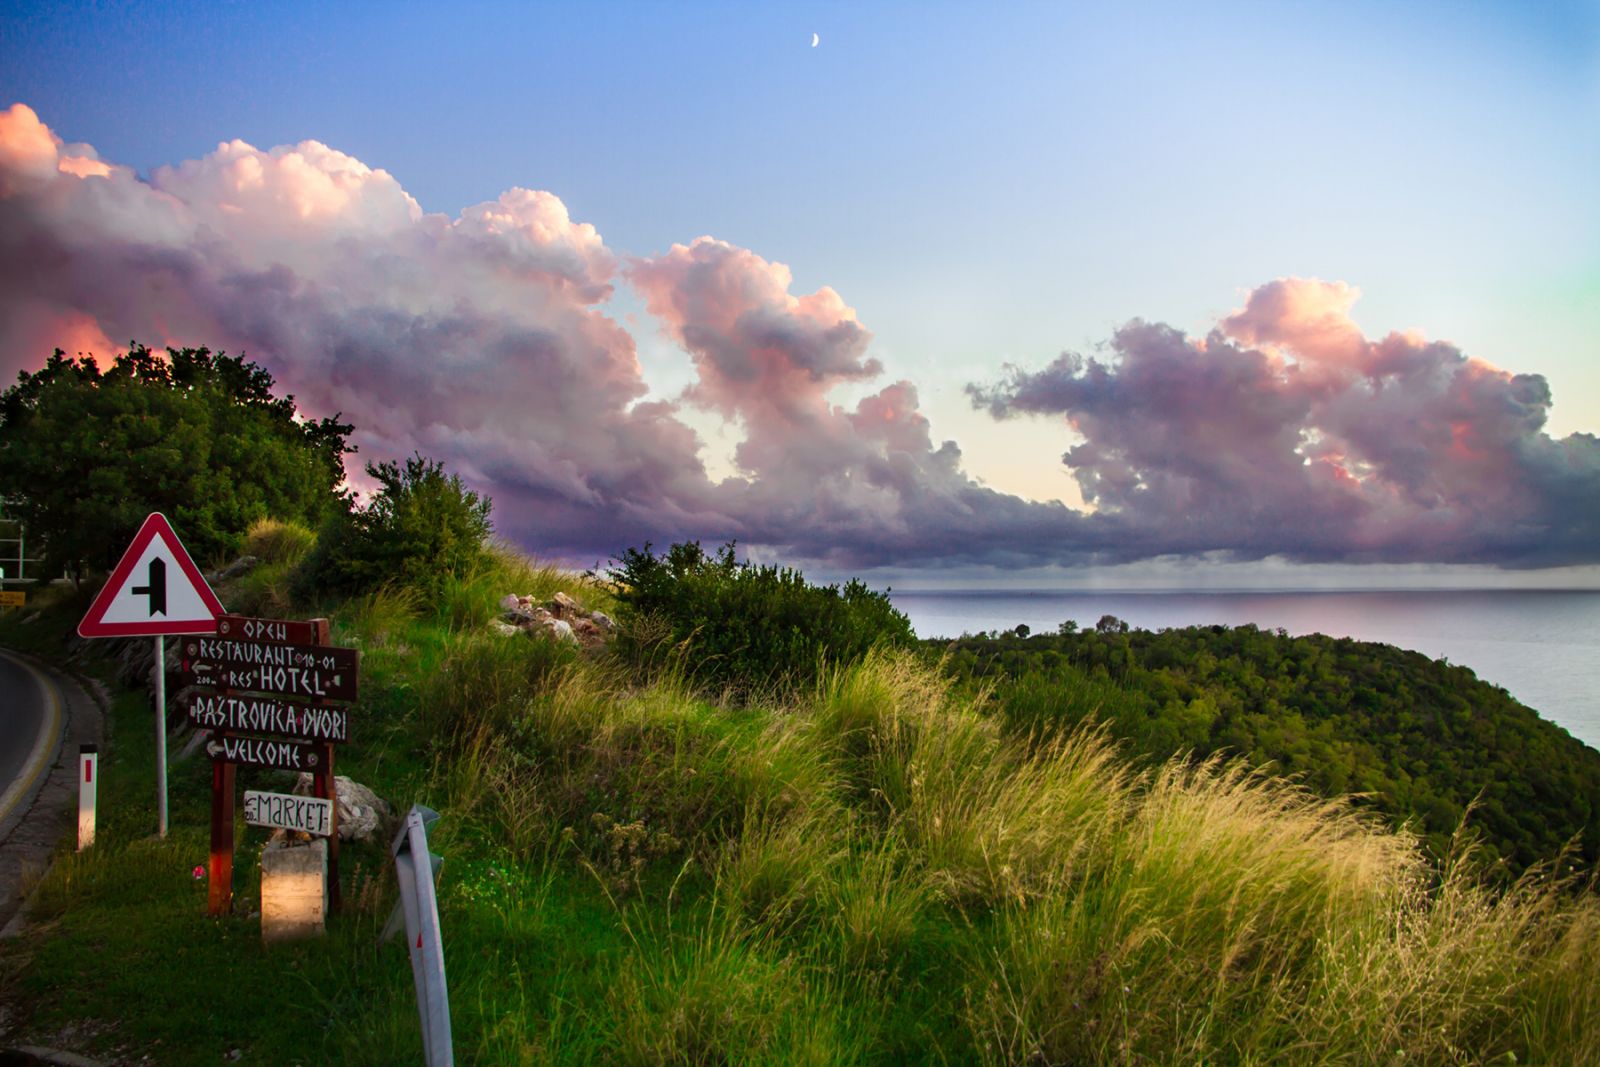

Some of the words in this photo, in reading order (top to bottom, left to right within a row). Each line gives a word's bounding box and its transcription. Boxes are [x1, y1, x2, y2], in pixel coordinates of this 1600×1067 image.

[243, 620, 287, 641] OPEN
[200, 638, 295, 666] RESTAURANT
[229, 670, 252, 688] RES
[260, 664, 326, 696] HOTEL
[303, 707, 347, 741] DVORI
[223, 738, 301, 769] WELCOME
